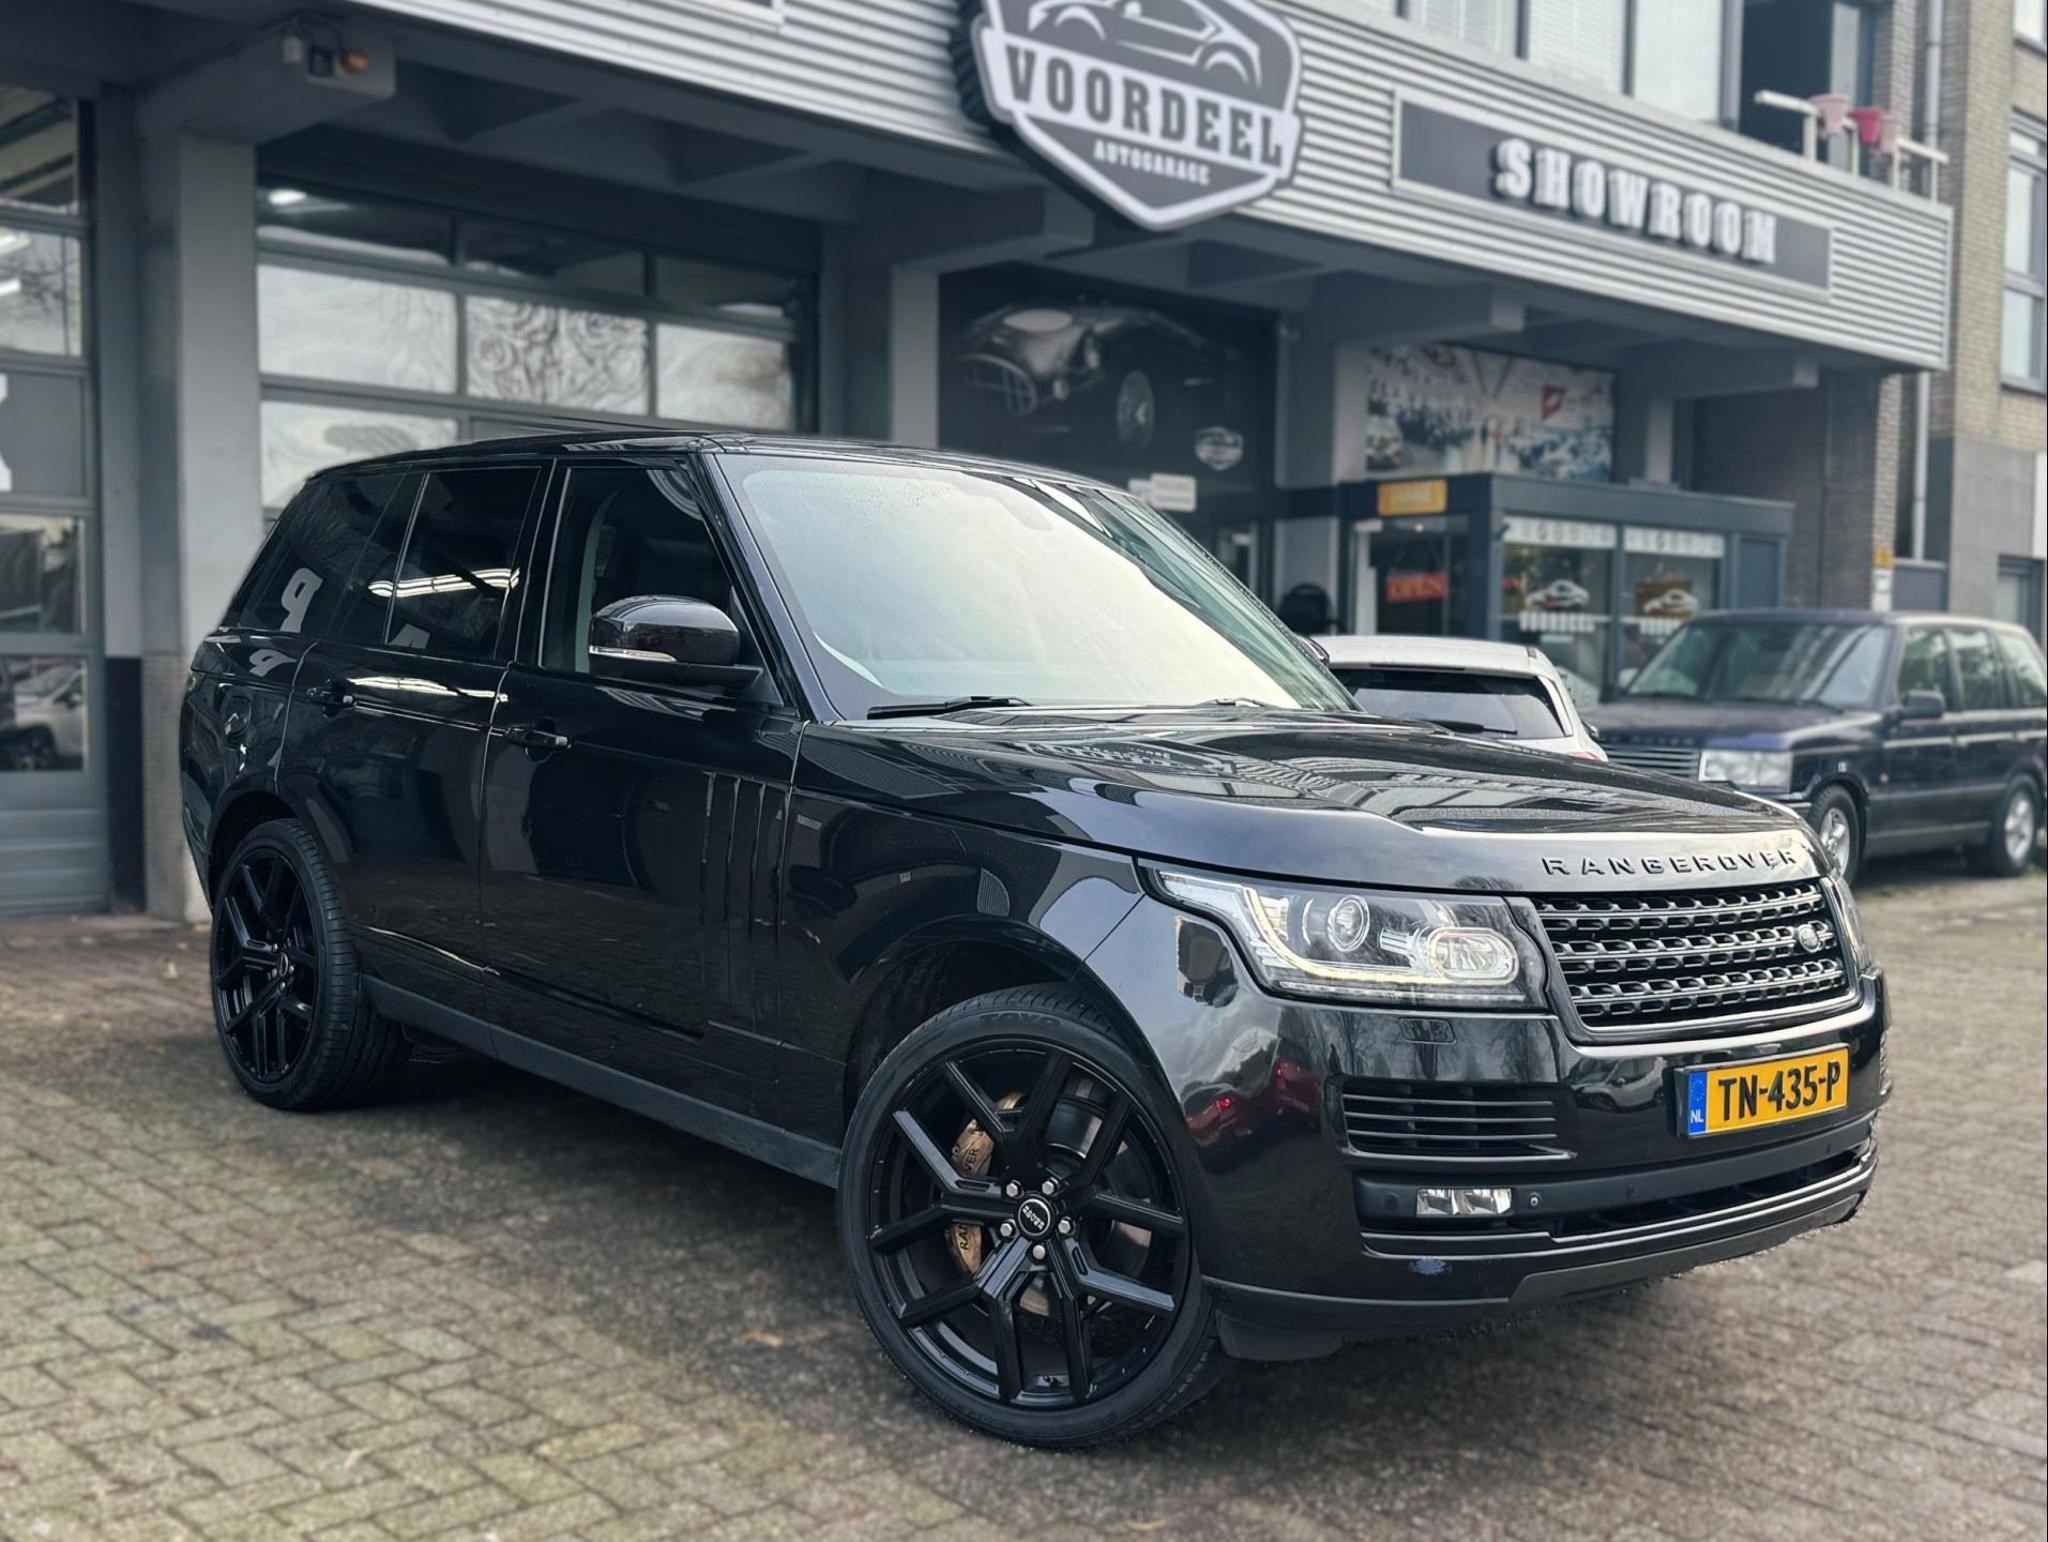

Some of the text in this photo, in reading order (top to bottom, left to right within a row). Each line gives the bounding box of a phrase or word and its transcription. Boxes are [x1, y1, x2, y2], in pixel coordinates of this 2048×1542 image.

[1005, 44, 1282, 168] VOORDEEL
[1094, 138, 1210, 186] AUTOGARAGE
[1495, 137, 1776, 264] SHOWROOM
[1690, 1110, 1704, 1123] NL
[1717, 1060, 1841, 1122] TN-435-P
